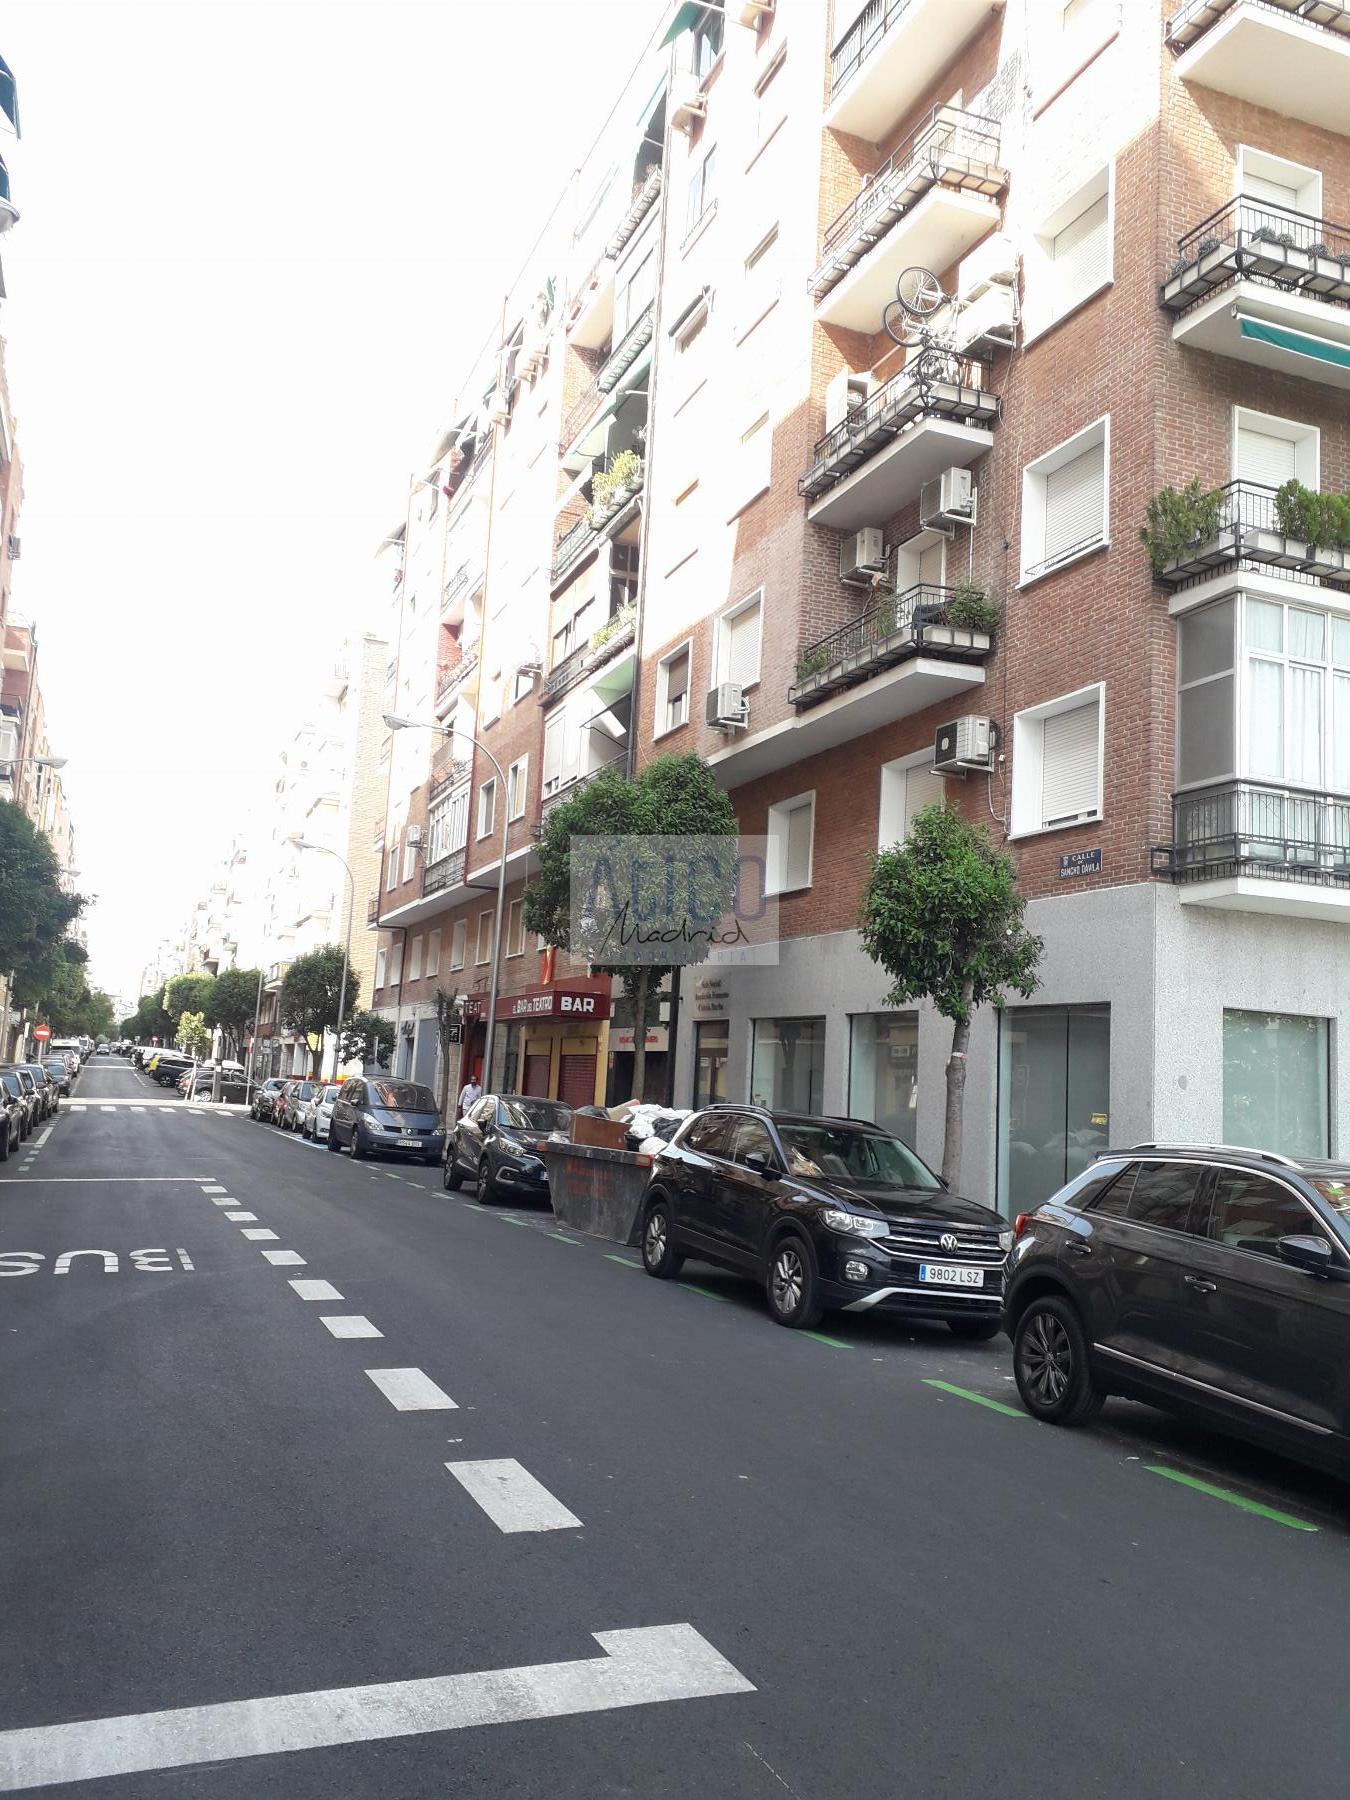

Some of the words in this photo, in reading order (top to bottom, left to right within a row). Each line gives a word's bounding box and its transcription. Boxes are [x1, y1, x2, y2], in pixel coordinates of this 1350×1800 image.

[1072, 852, 1095, 861] CALLE
[1061, 866, 1080, 877] SANCHO
[517, 999, 528, 1014] BAR
[532, 995, 553, 1012] TEATRO
[560, 996, 595, 1013] BAR
[929, 1268, 957, 1282] 9802
[960, 1270, 980, 1284] LSZ
